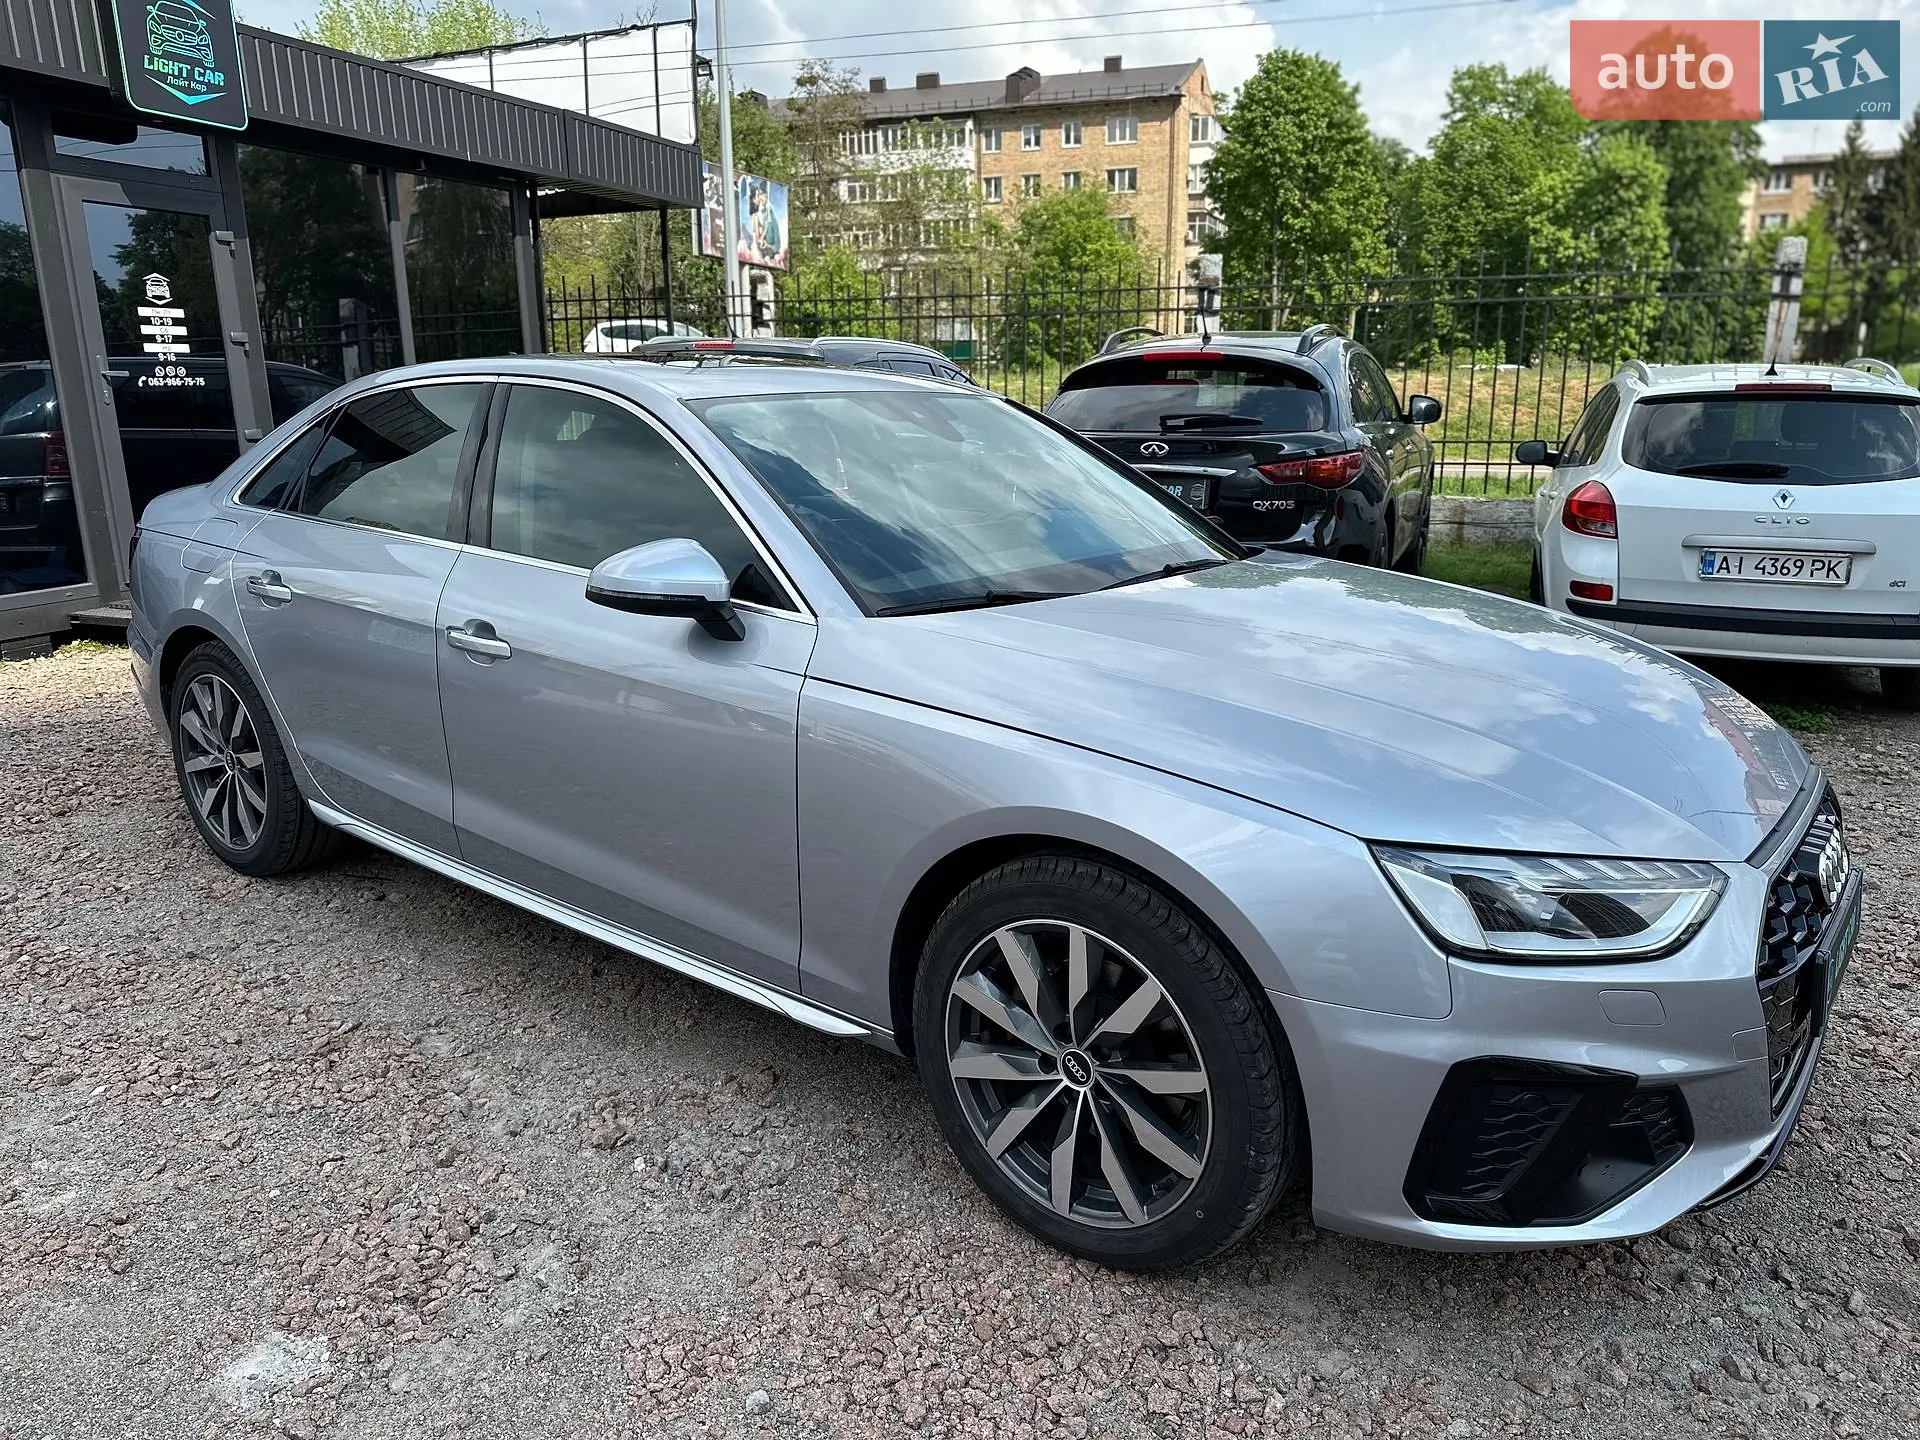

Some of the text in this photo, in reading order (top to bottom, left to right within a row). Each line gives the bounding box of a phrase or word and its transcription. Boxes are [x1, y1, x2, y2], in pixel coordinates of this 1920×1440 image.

[144, 54, 224, 86] LIGHT CAR
[167, 75, 207, 92] Лайт Кар
[150, 317, 172, 326] 10-19
[155, 335, 172, 343] 9-17
[157, 352, 176, 361] 9-16
[148, 377, 205, 386] 063-966-75-75
[1252, 500, 1296, 512] QX70S
[1754, 515, 1811, 525] CLIO
[1715, 555, 1843, 579] AI 4369 PK
